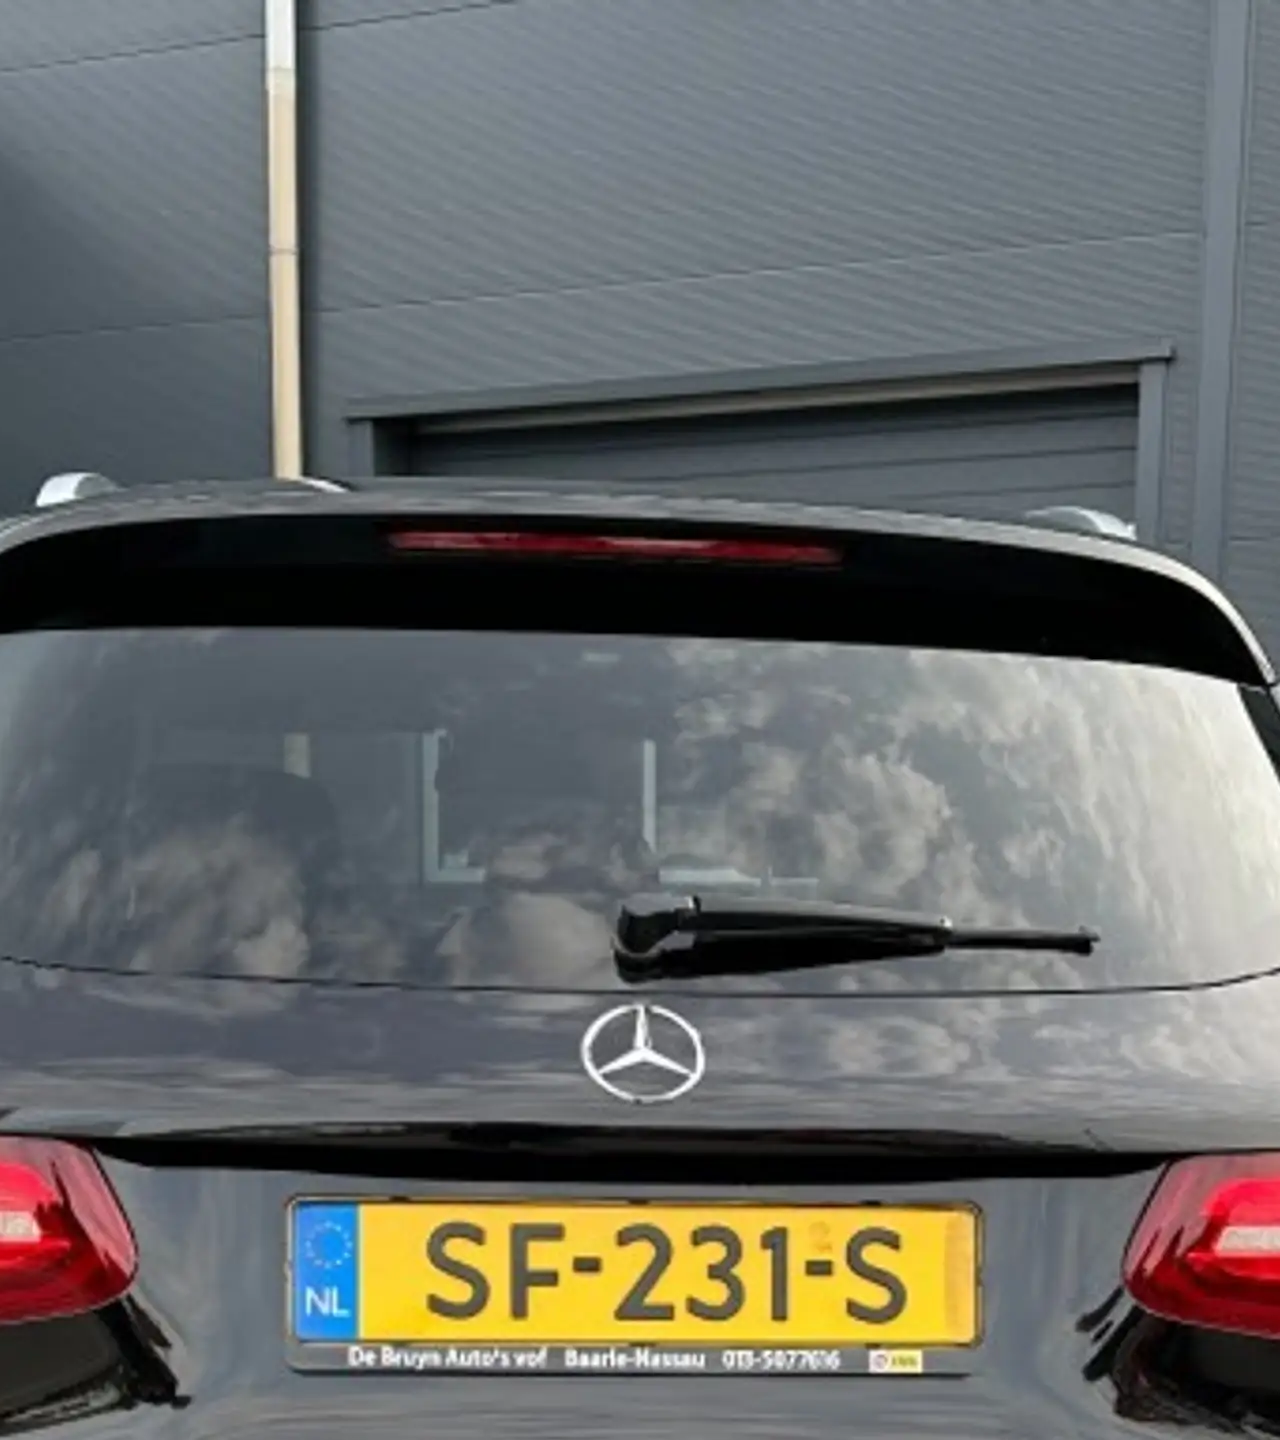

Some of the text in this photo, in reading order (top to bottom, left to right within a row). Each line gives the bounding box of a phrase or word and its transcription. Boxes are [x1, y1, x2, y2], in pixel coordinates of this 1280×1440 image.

[426, 1221, 907, 1324] SF-231-S
[305, 1285, 350, 1317] NL
[347, 1346, 377, 1367] De
[381, 1346, 441, 1370] Bruyn
[445, 1349, 510, 1367] Auto's
